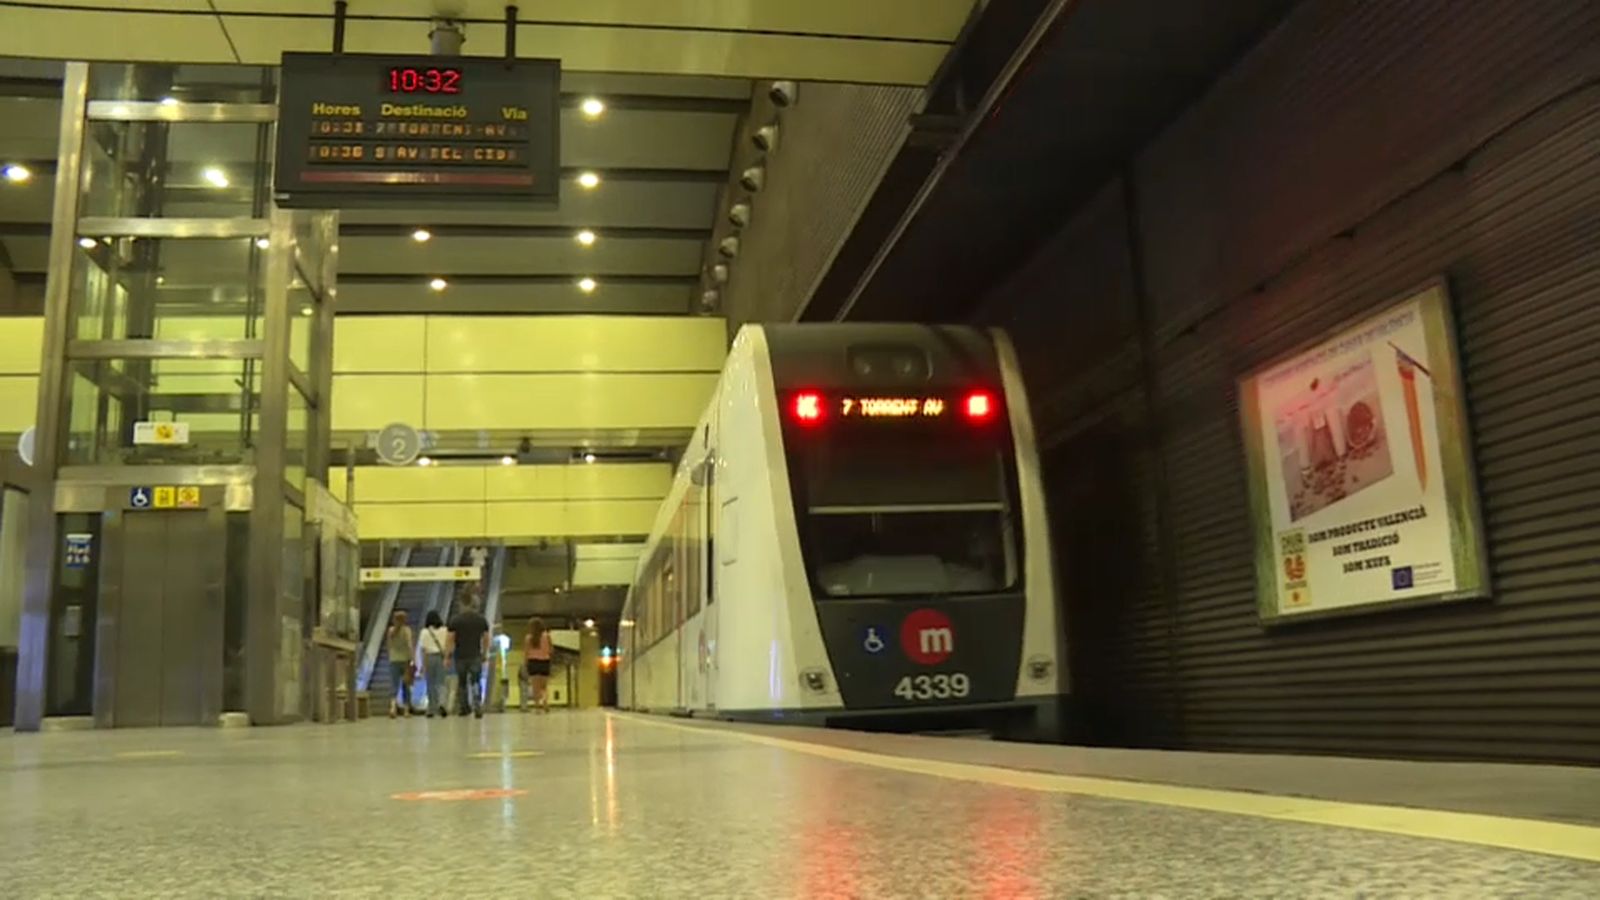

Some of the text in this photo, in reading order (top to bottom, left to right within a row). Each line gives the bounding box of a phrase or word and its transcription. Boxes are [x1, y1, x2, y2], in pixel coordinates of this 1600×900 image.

[389, 69, 461, 92] 10:32
[312, 102, 528, 120] Hores Destinació Via
[842, 399, 944, 416] 7 TORRENT AV
[391, 438, 407, 459] 2
[894, 672, 969, 699] 4339
